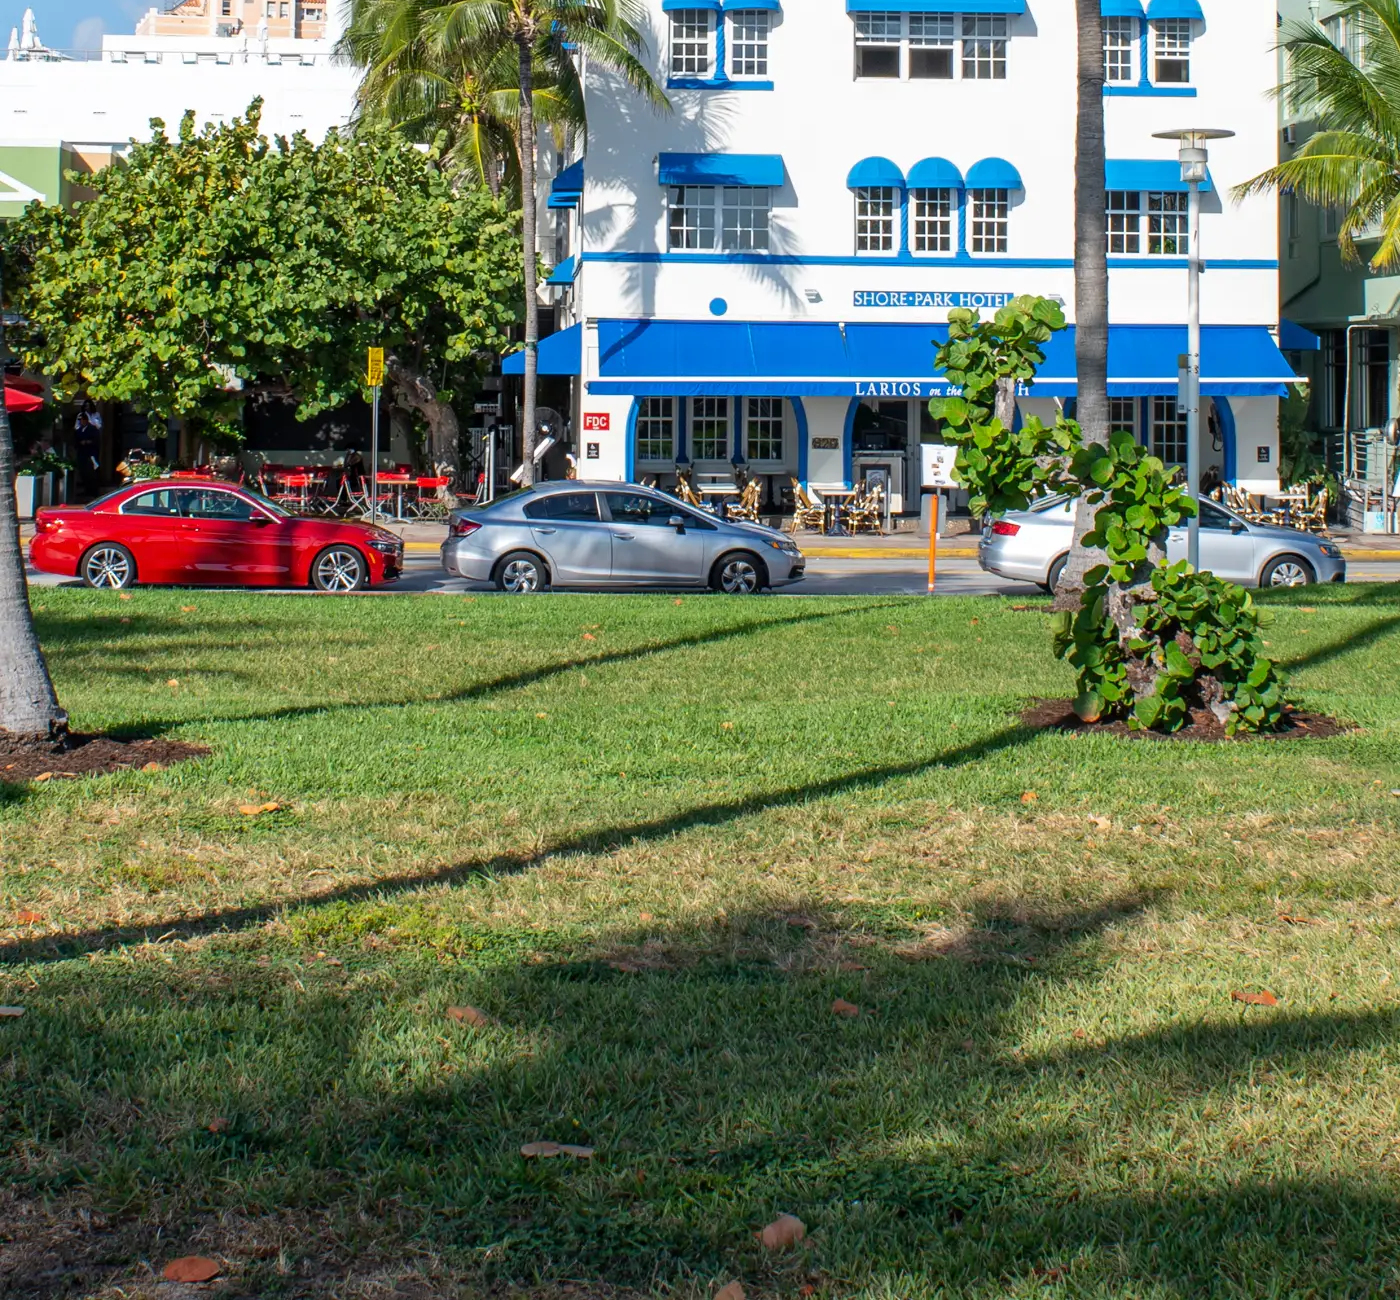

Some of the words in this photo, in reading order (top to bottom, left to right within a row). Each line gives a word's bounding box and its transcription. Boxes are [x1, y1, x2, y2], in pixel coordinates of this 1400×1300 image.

[855, 382, 921, 396] LARIOS
[929, 387, 941, 396] on
[946, 385, 963, 396] the
[586, 416, 607, 427] FDC
